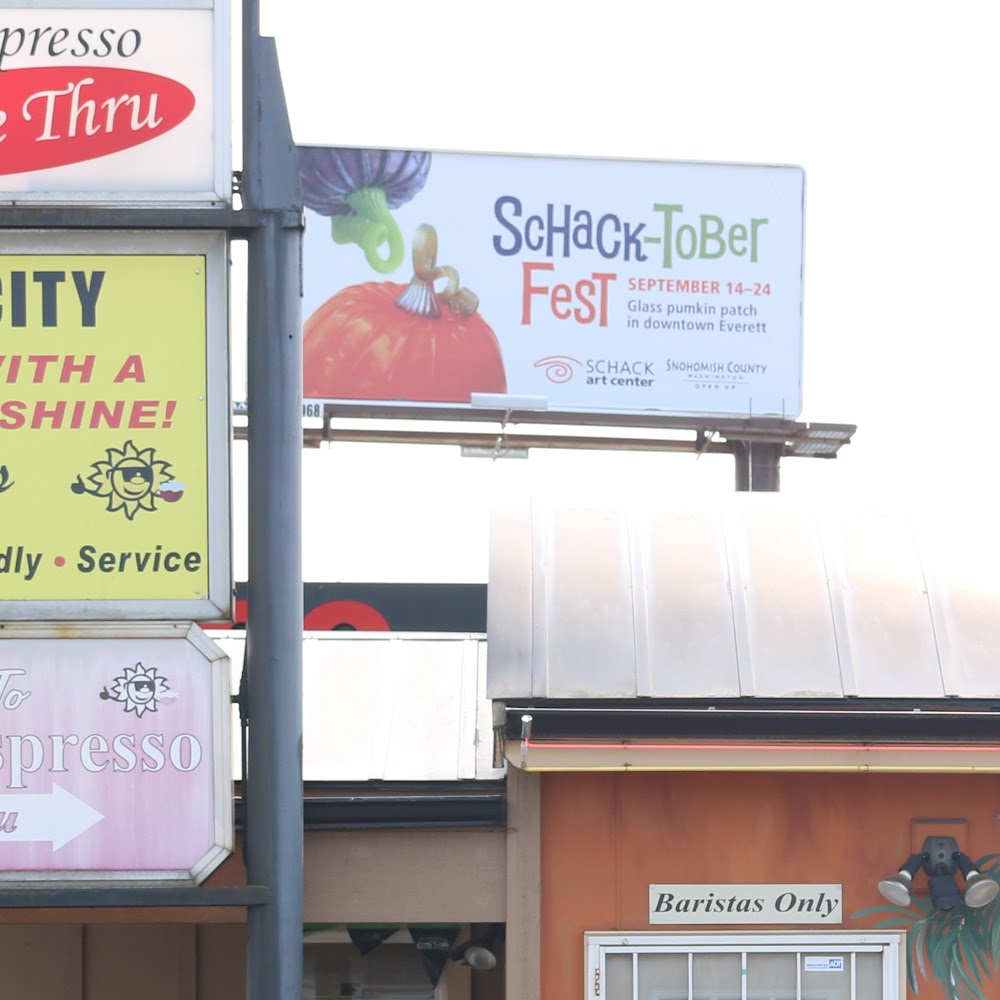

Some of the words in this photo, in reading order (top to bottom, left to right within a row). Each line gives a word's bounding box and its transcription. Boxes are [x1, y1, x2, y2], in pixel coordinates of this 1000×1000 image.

[22, 77, 163, 142] Thru
[628, 277, 720, 294] SEPTEMBER
[0, 271, 106, 328] ITY
[627, 299, 663, 314] Glass
[667, 301, 716, 316] pumkin
[720, 304, 757, 318] patch
[627, 315, 640, 329] in
[644, 316, 715, 332] downtown
[719, 319, 767, 333] Everett
[0, 355, 96, 383] ITH
[114, 355, 146, 383] A
[586, 359, 655, 376] SCHACK
[666, 358, 724, 373] SNOHOMISH
[727, 361, 768, 374] COUNTY
[586, 375, 608, 386] art
[610, 377, 655, 387] center
[0, 400, 177, 429] SHINE!
[77, 545, 201, 573] Service
[0, 733, 202, 788] presso
[653, 892, 764, 913] Baristas
[774, 892, 839, 918] Only
